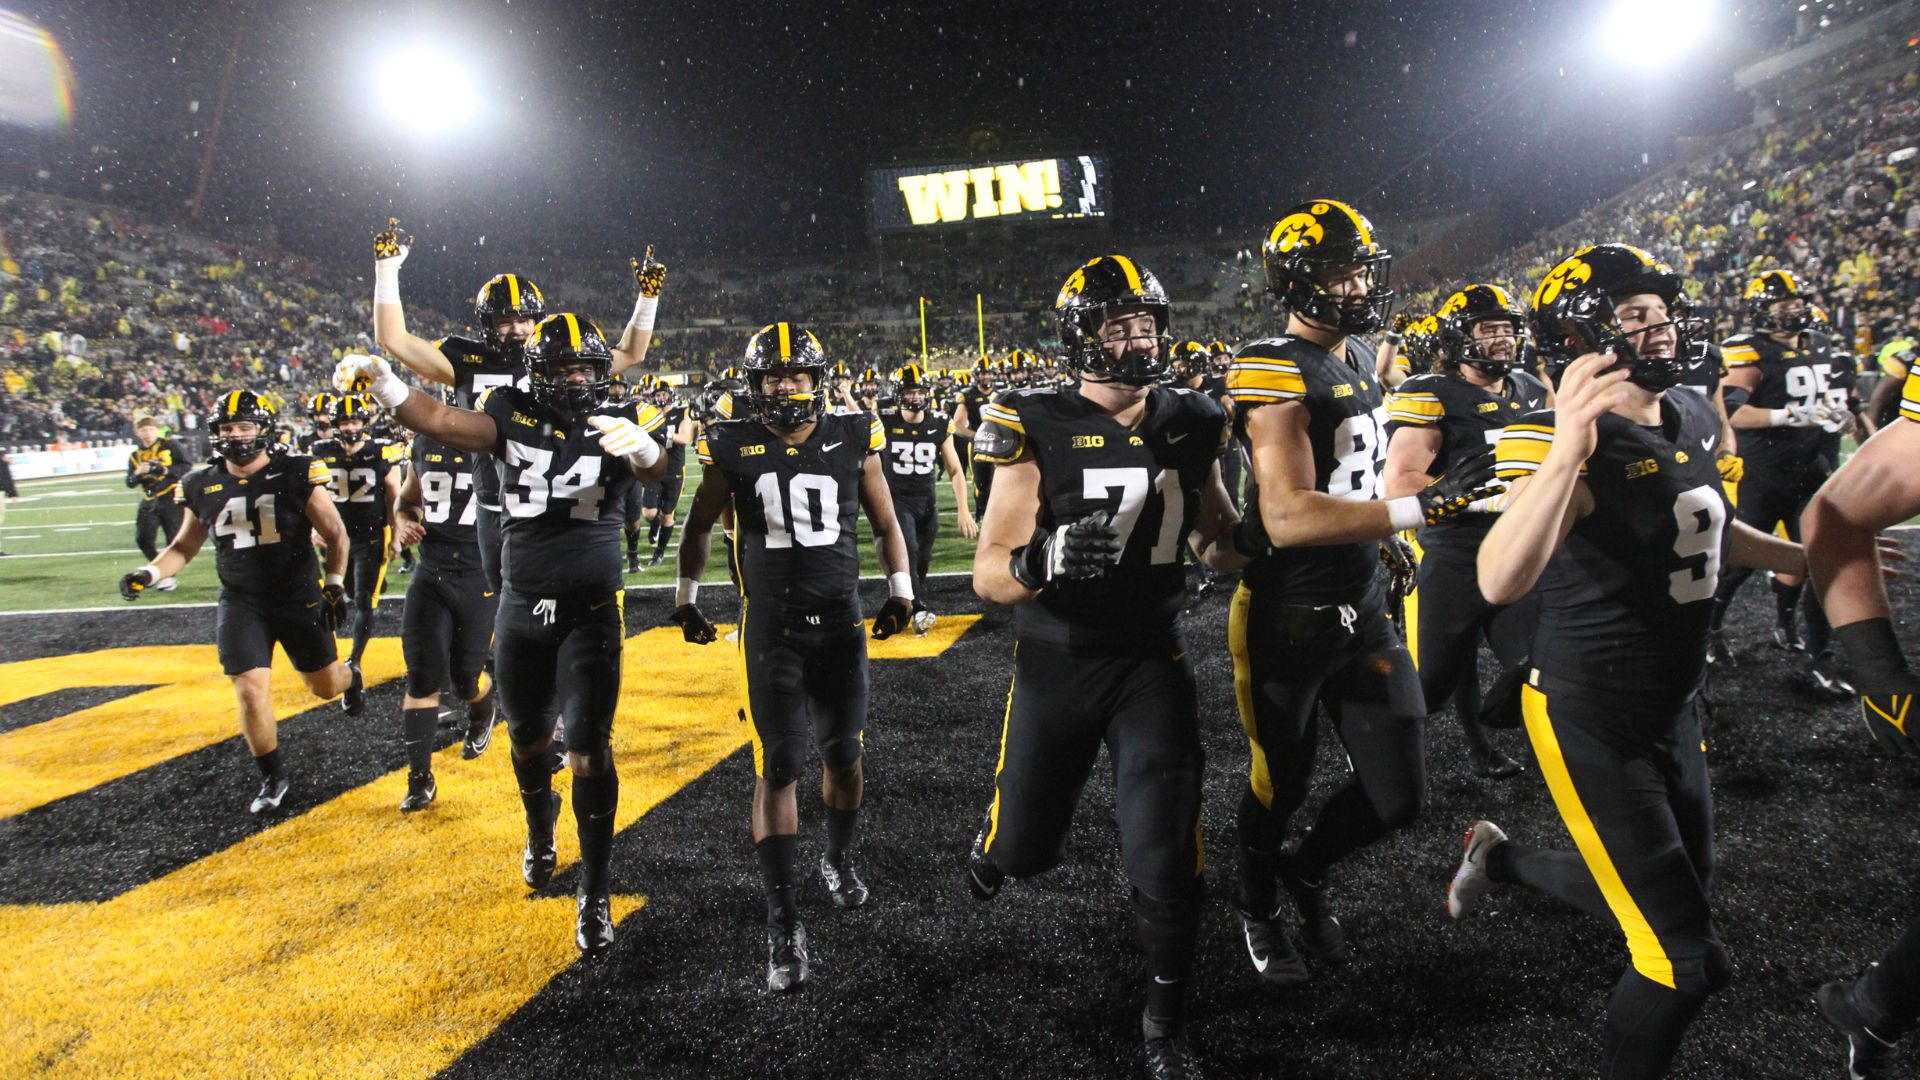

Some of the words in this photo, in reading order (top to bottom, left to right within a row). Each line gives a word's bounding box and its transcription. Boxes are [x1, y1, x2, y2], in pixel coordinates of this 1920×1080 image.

[898, 159, 1063, 225] WIN!
[326, 467, 375, 503] 92
[505, 439, 605, 521] 34
[891, 441, 937, 475] 39
[215, 494, 282, 550] 41
[420, 471, 477, 526] 97
[755, 472, 841, 549] 10
[1083, 467, 1185, 565] 71
[1669, 485, 1727, 605] 9
